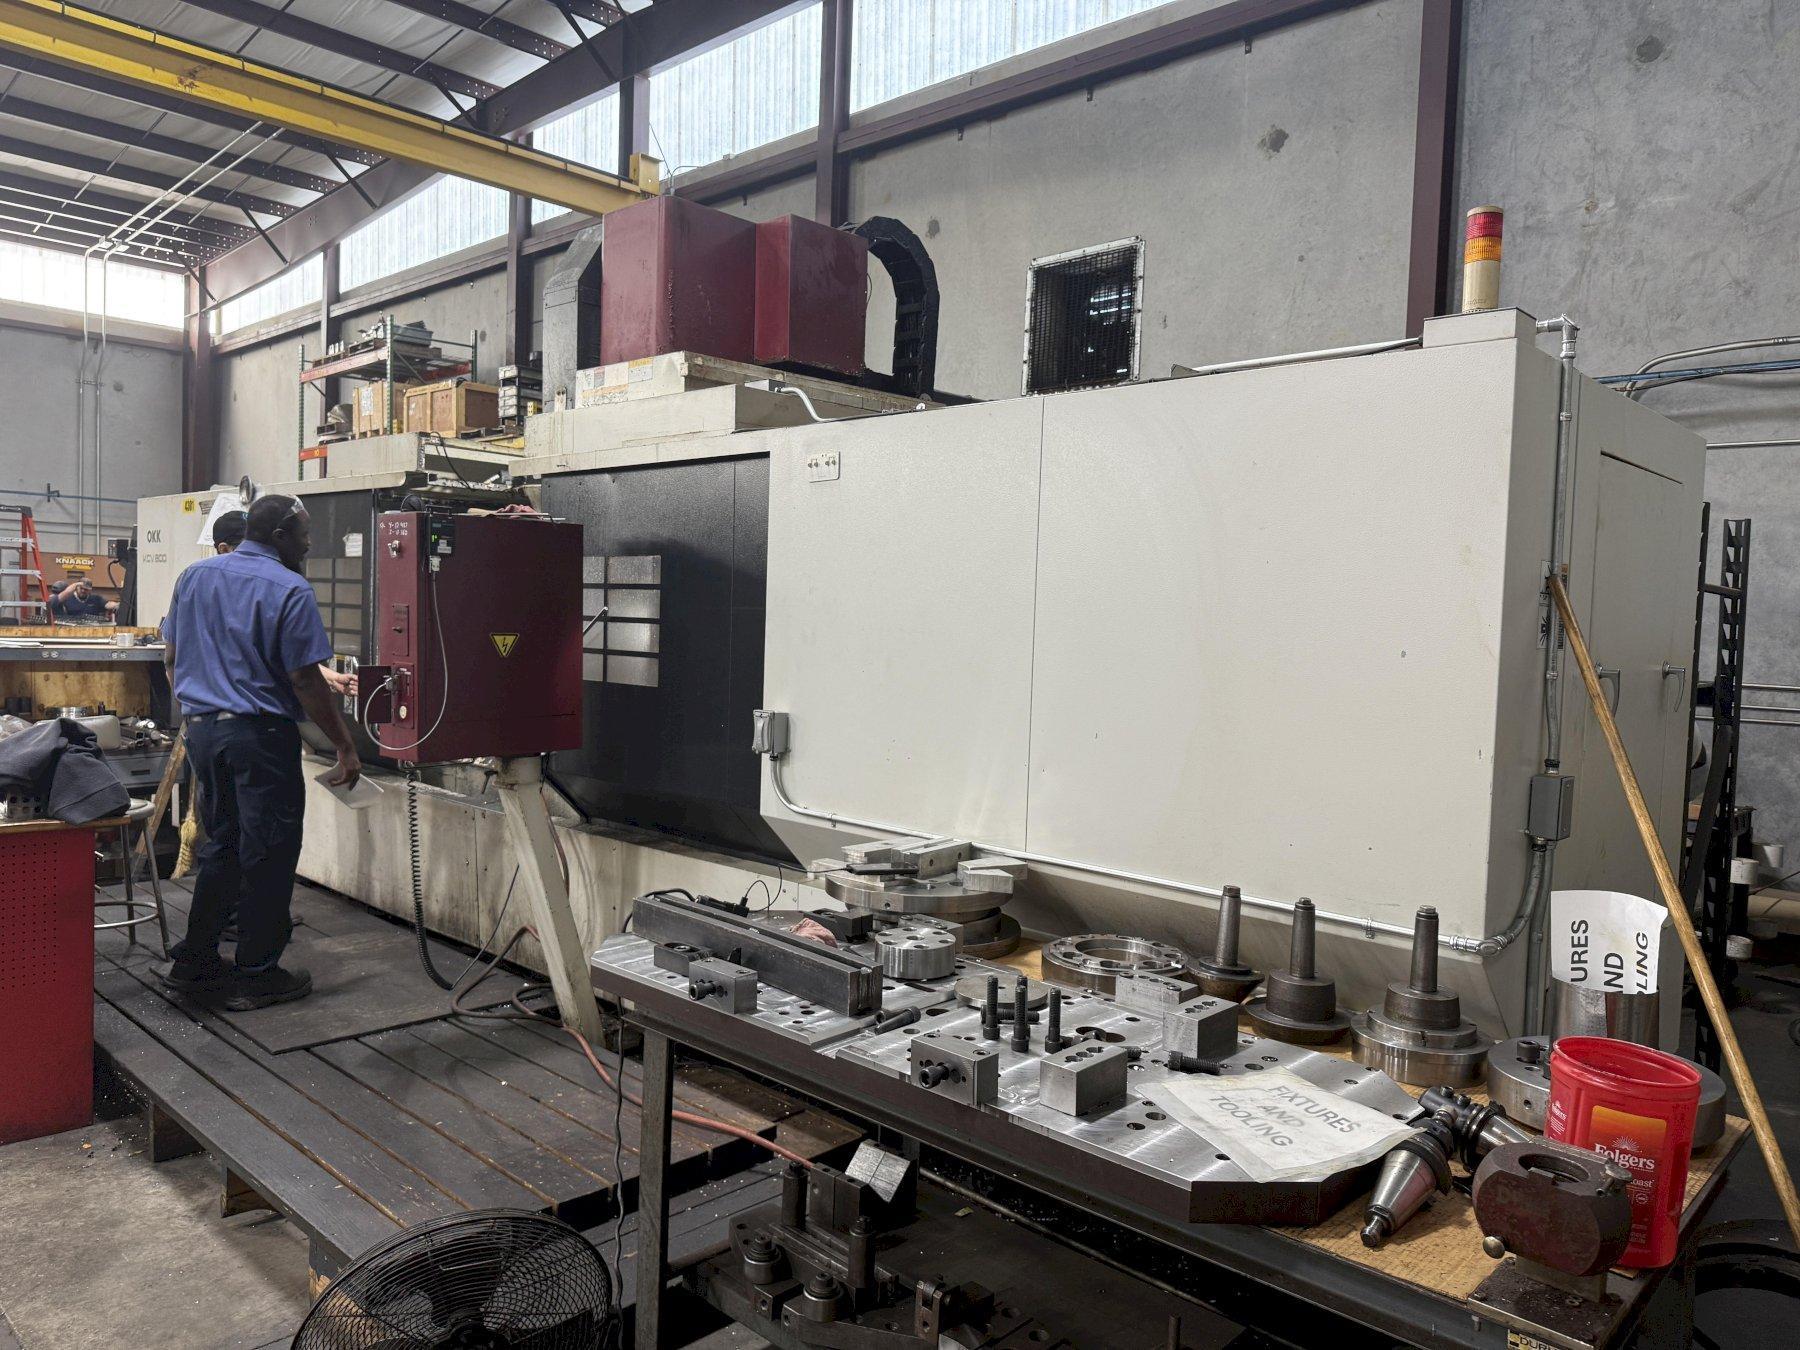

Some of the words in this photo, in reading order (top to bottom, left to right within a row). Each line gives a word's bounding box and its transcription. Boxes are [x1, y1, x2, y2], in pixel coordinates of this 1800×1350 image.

[147, 530, 161, 543] OKK
[55, 557, 95, 566] KNAACK
[1571, 920, 1589, 982] URES
[1604, 953, 1624, 992] ND
[1209, 1095, 1293, 1147] TOOLING
[1257, 1104, 1305, 1128] AND
[1268, 1085, 1362, 1134] FIXTURES
[1595, 1143, 1655, 1170] Folgers
[1630, 1178, 1653, 1188] oast
